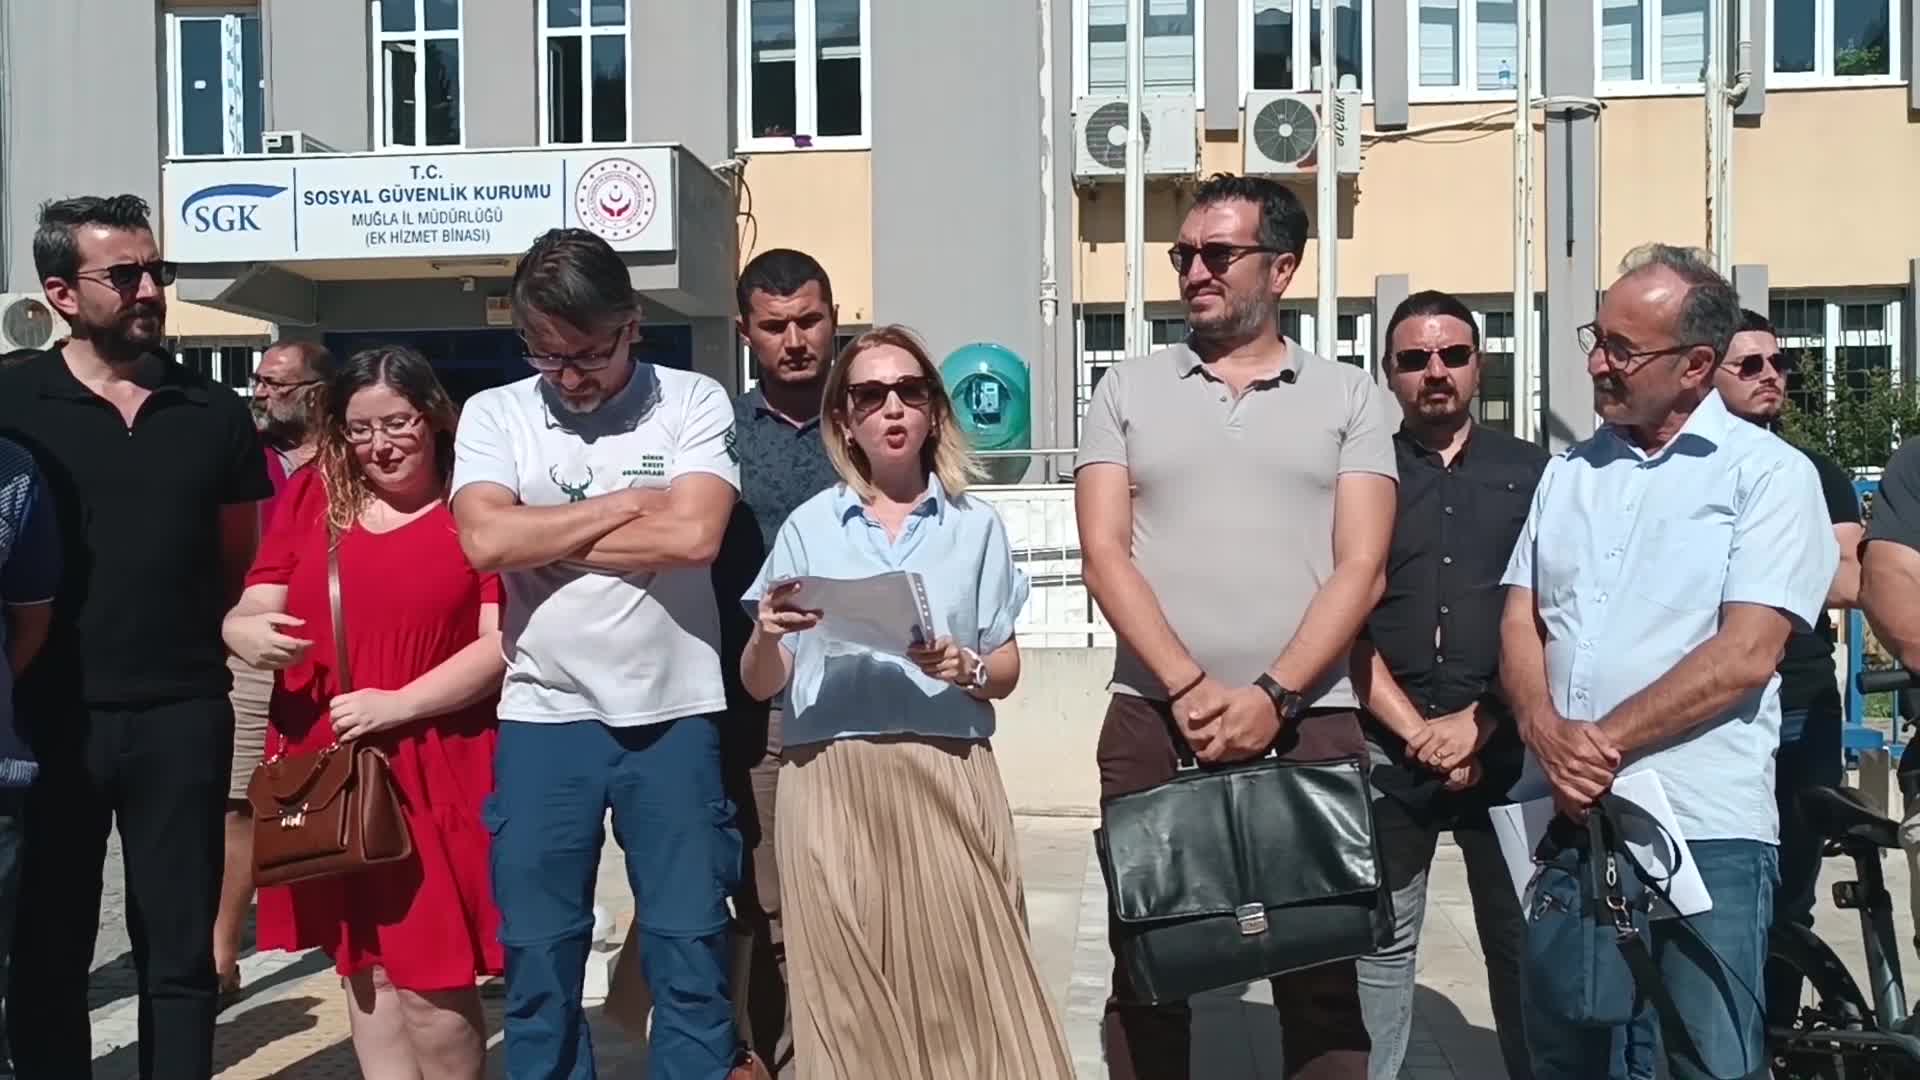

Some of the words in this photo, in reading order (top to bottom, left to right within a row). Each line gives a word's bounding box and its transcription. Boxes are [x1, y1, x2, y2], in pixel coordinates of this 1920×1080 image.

[409, 164, 443, 180] T.C.
[303, 189, 374, 206] SOSYAL
[378, 183, 468, 203] GÜVENLİK
[473, 183, 551, 201] KURUMU
[194, 204, 262, 232] SGK
[351, 210, 399, 227] MUĞLA
[402, 210, 414, 225] İL
[418, 206, 503, 225] MÜDÜRLÜĞÜ
[365, 231, 387, 248] (EK
[390, 227, 438, 244] HİZMET
[442, 226, 491, 244] BİNASI)
